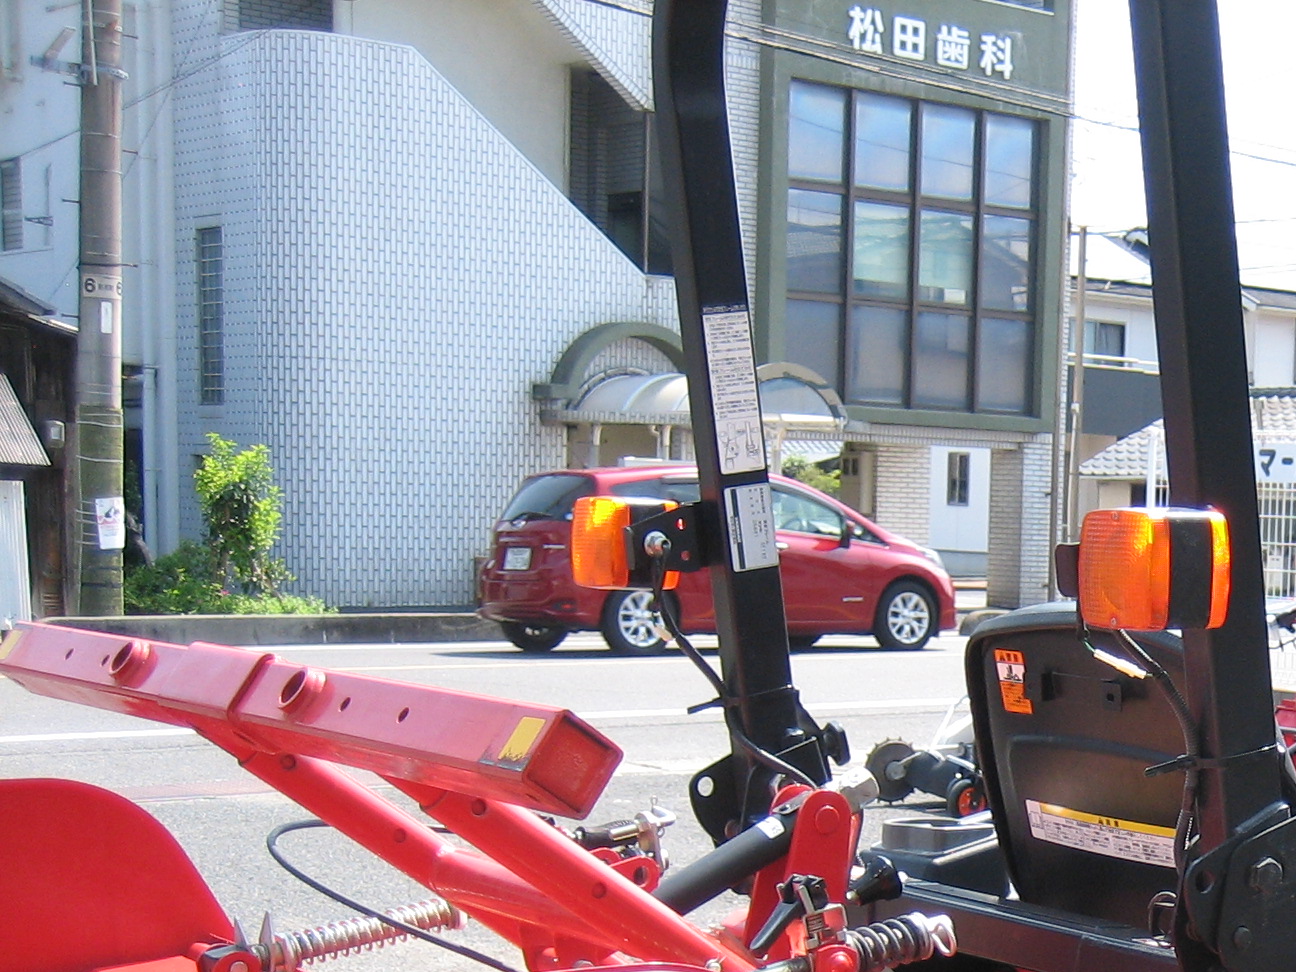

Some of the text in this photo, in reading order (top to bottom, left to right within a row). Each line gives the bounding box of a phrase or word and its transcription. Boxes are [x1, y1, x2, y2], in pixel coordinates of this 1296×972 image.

[848, 5, 1014, 80] 松田歯科
[85, 277, 96, 293] 6
